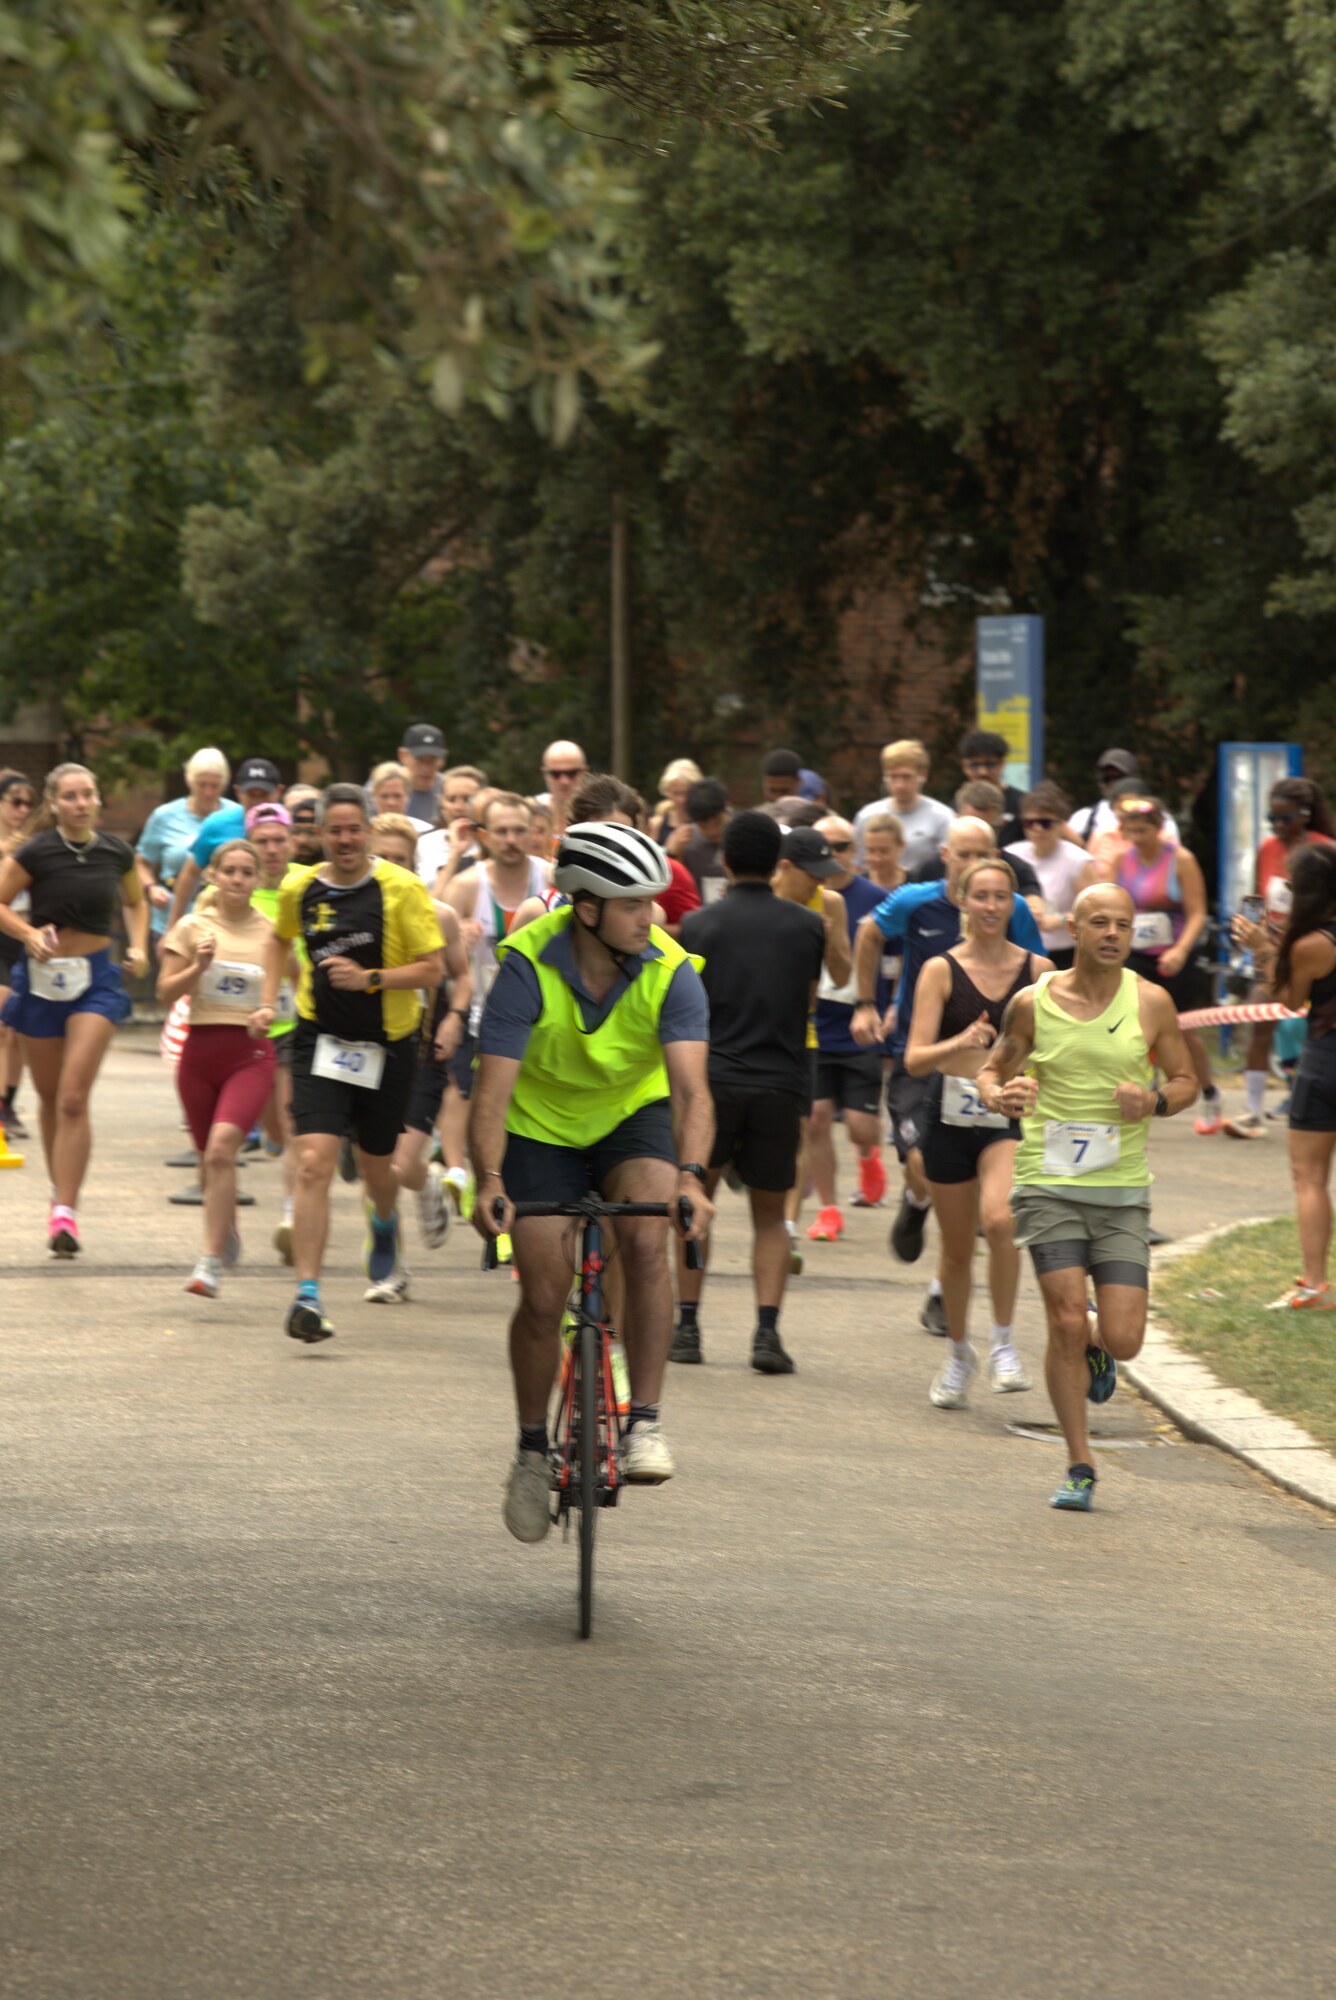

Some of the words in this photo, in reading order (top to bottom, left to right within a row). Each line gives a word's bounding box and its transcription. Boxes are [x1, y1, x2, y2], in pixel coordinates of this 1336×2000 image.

[51, 971, 66, 991] 4
[216, 975, 248, 995] 49
[332, 1050, 366, 1073] 40
[1072, 1139, 1090, 1163] 7
